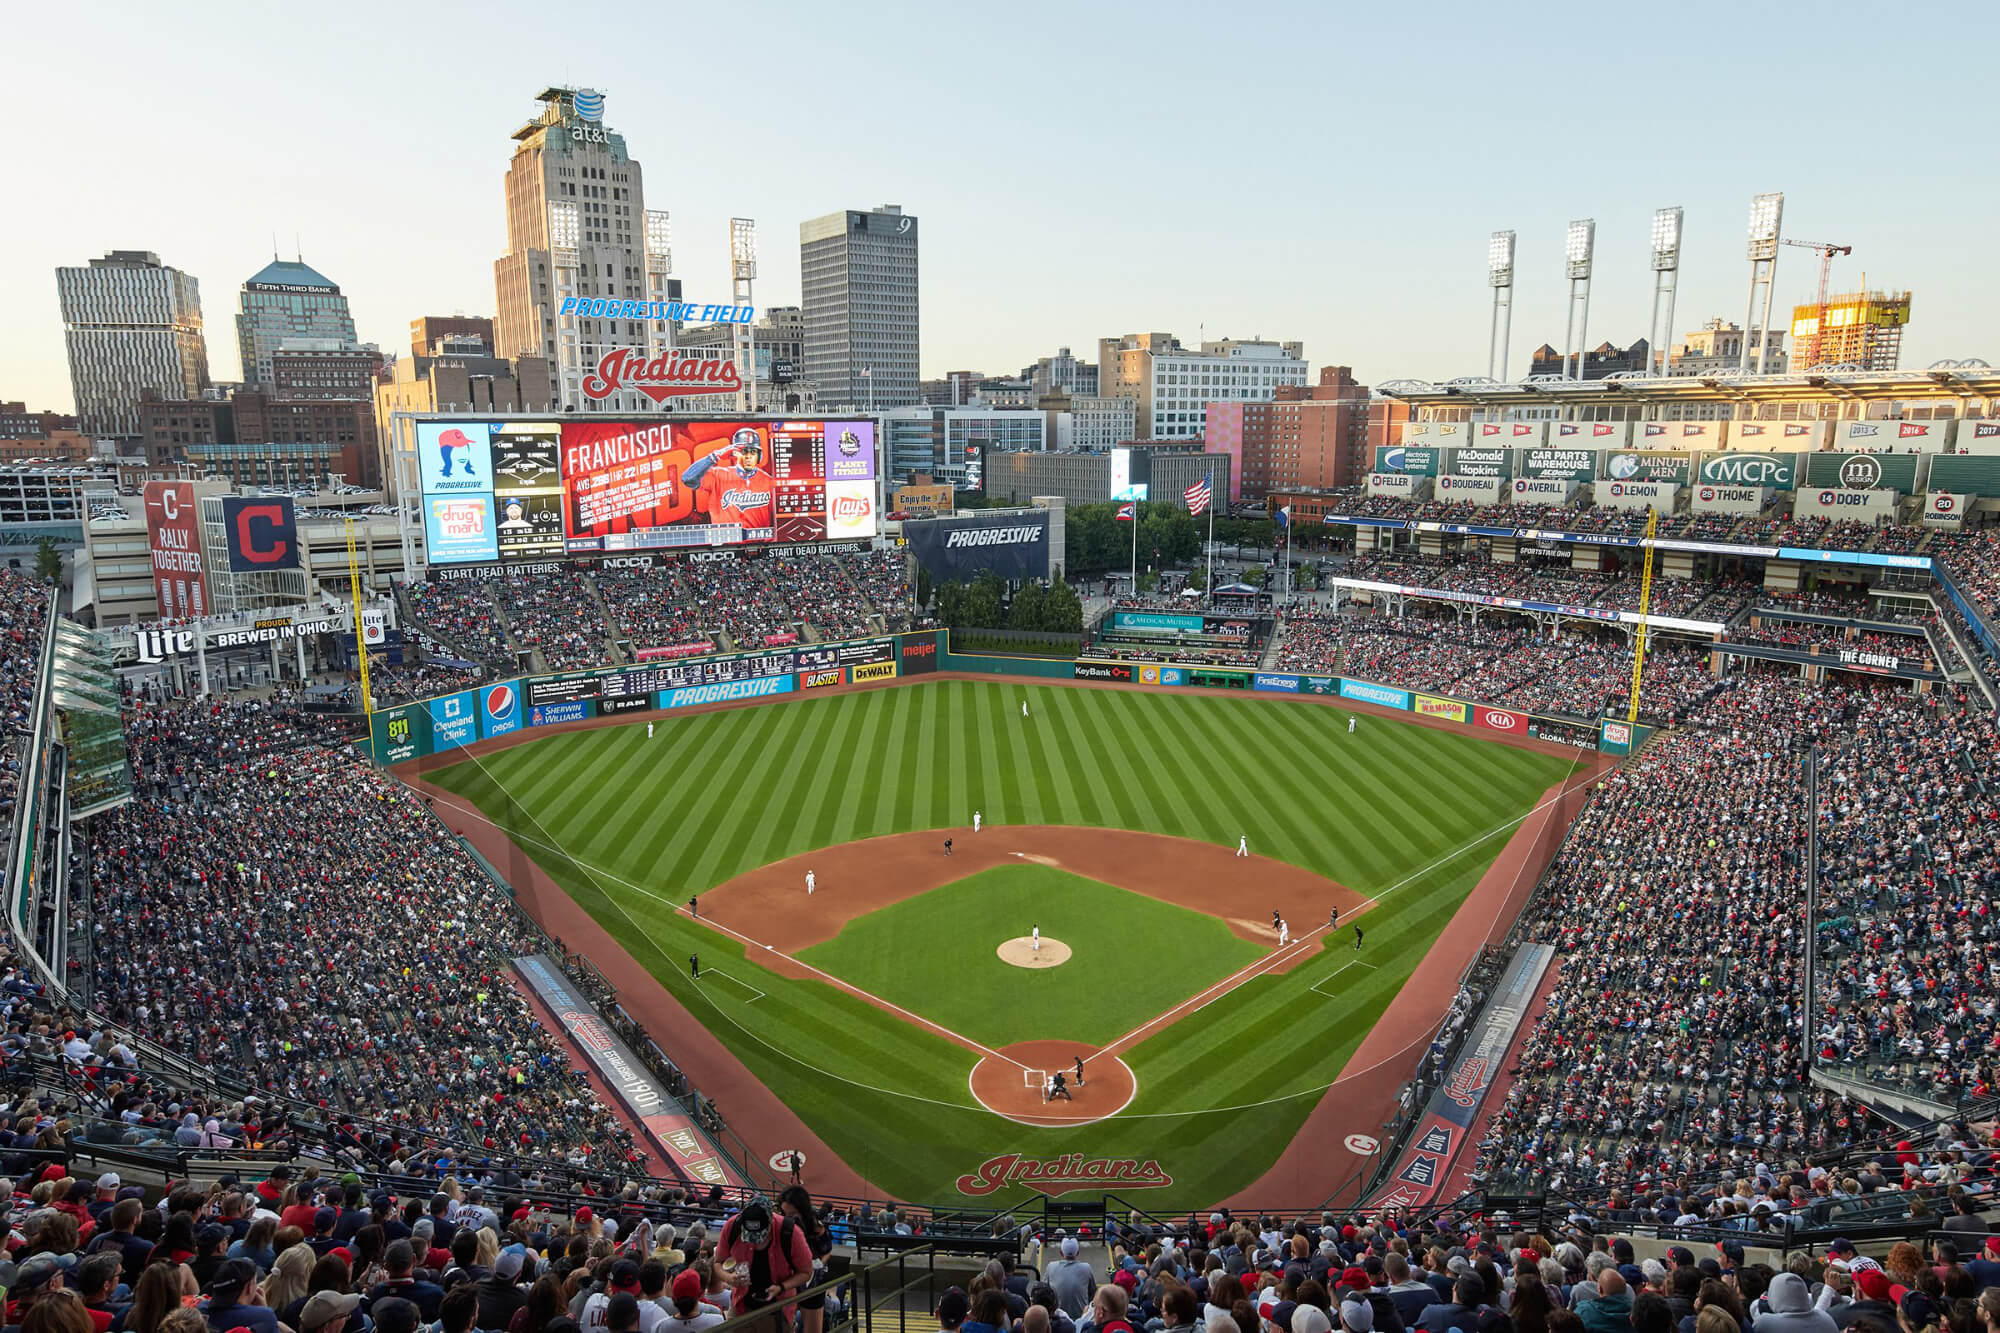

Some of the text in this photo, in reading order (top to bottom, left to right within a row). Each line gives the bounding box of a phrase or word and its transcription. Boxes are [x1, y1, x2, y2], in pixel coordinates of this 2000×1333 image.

[573, 123, 610, 144] at&t
[281, 284, 308, 293] THIRD
[560, 296, 754, 324] PROGRESSIVE FIELD
[582, 348, 742, 402] Indians
[1852, 426, 1869, 434] 2013
[1902, 426, 1919, 434] 2016
[1978, 426, 1997, 434] 2017
[568, 424, 672, 475] FRANCISCO
[1457, 450, 1504, 461] McDonald
[1531, 451, 1588, 461] CAR PARTS
[1528, 460, 1591, 470] WAREHOUSE
[1640, 457, 1689, 468] MINUTE
[1460, 465, 1499, 477] Hopkins
[1649, 468, 1677, 477] MEN
[435, 481, 483, 489] PROGRESSIVE
[1382, 477, 1408, 486] FELLER
[1452, 479, 1493, 489] BOUDREAU
[1527, 482, 1562, 493] AVERILL
[1624, 486, 1658, 496] LEMON
[1701, 490, 1754, 501] 25 THOME
[163, 489, 178, 520] C
[722, 488, 770, 511] Indians
[1820, 493, 1869, 506] 14 DOBY
[1936, 500, 1951, 508] 20
[443, 504, 475, 521] drug
[1924, 512, 1961, 521] ROBINSON
[448, 510, 485, 534] mart
[160, 528, 189, 549] RALLY
[236, 505, 287, 563] C
[946, 526, 1043, 548] PROGRESSIVE
[689, 551, 735, 563] NOCO
[769, 548, 795, 558] START
[796, 546, 816, 555] DEAD
[152, 550, 202, 573] TOGETHER
[603, 557, 653, 569] NOCO
[440, 563, 563, 580] START DEAD BATTERIES.
[255, 617, 292, 629] PROUDLY
[1136, 616, 1165, 624] MEDICAL
[218, 621, 328, 647] BREWED IN OHIO
[134, 629, 193, 664] Lite
[903, 641, 936, 658] meijer
[1839, 650, 1899, 670] THE CORNER
[806, 672, 840, 688] BLASTER
[1075, 667, 1111, 677] KeyBank
[670, 678, 781, 706] PROGRESSIVE
[1343, 684, 1403, 705] PROGRESSIVE
[545, 704, 582, 715] SHERWIN
[617, 699, 645, 708] RAM
[1436, 704, 1462, 713] MASON
[388, 718, 409, 737] 811
[433, 714, 474, 733] Cleveland
[492, 721, 515, 735] pepsi
[1490, 713, 1512, 727] KIA
[443, 727, 467, 740] Clinic
[1606, 723, 1625, 737] drug
[1539, 733, 1596, 751] GLOBAL POKER
[1486, 1005, 1517, 1028] 1901
[562, 1012, 616, 1051] Indians
[603, 1050, 637, 1081] ESTABLISHED
[1443, 1057, 1482, 1107] Indians
[624, 1079, 665, 1108] 1901
[670, 1132, 695, 1149] 1920
[1424, 1133, 1447, 1151] 2018
[695, 1162, 721, 1181] 1948
[956, 1153, 1173, 1197] Indians
[1408, 1162, 1432, 1182] 2017
